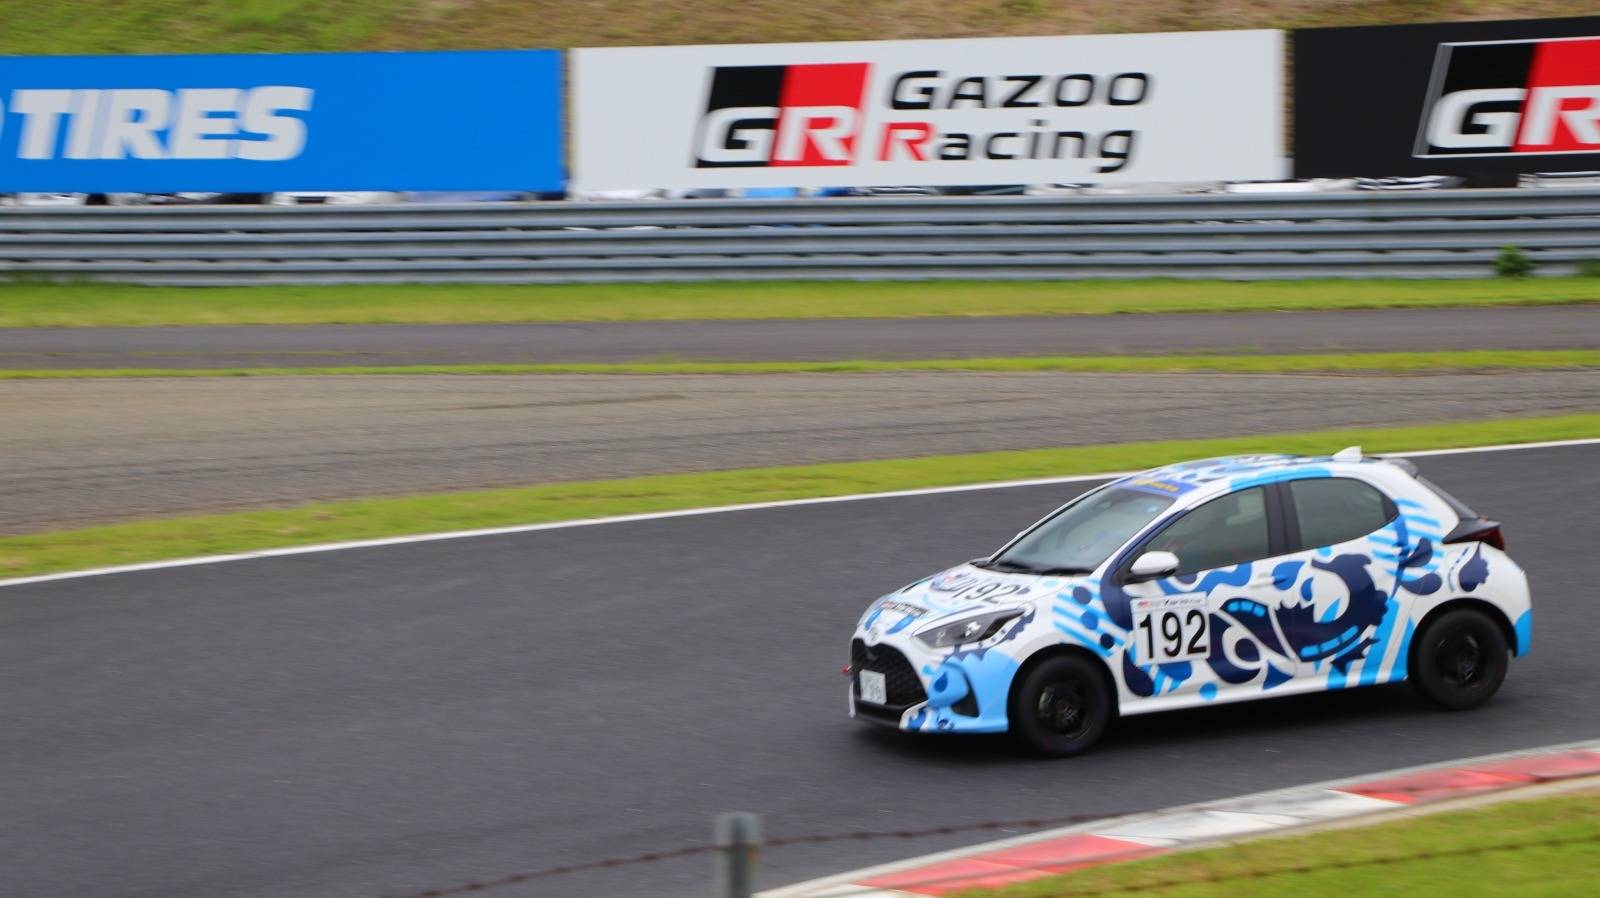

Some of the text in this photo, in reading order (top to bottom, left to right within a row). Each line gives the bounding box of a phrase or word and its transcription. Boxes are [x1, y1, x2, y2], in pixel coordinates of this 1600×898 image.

[9, 85, 315, 162] TIRES
[695, 104, 858, 164] GR
[1425, 85, 1600, 149] GR
[876, 119, 1139, 174] Racing
[951, 582, 1020, 605] 192
[1139, 609, 1208, 659] 192
